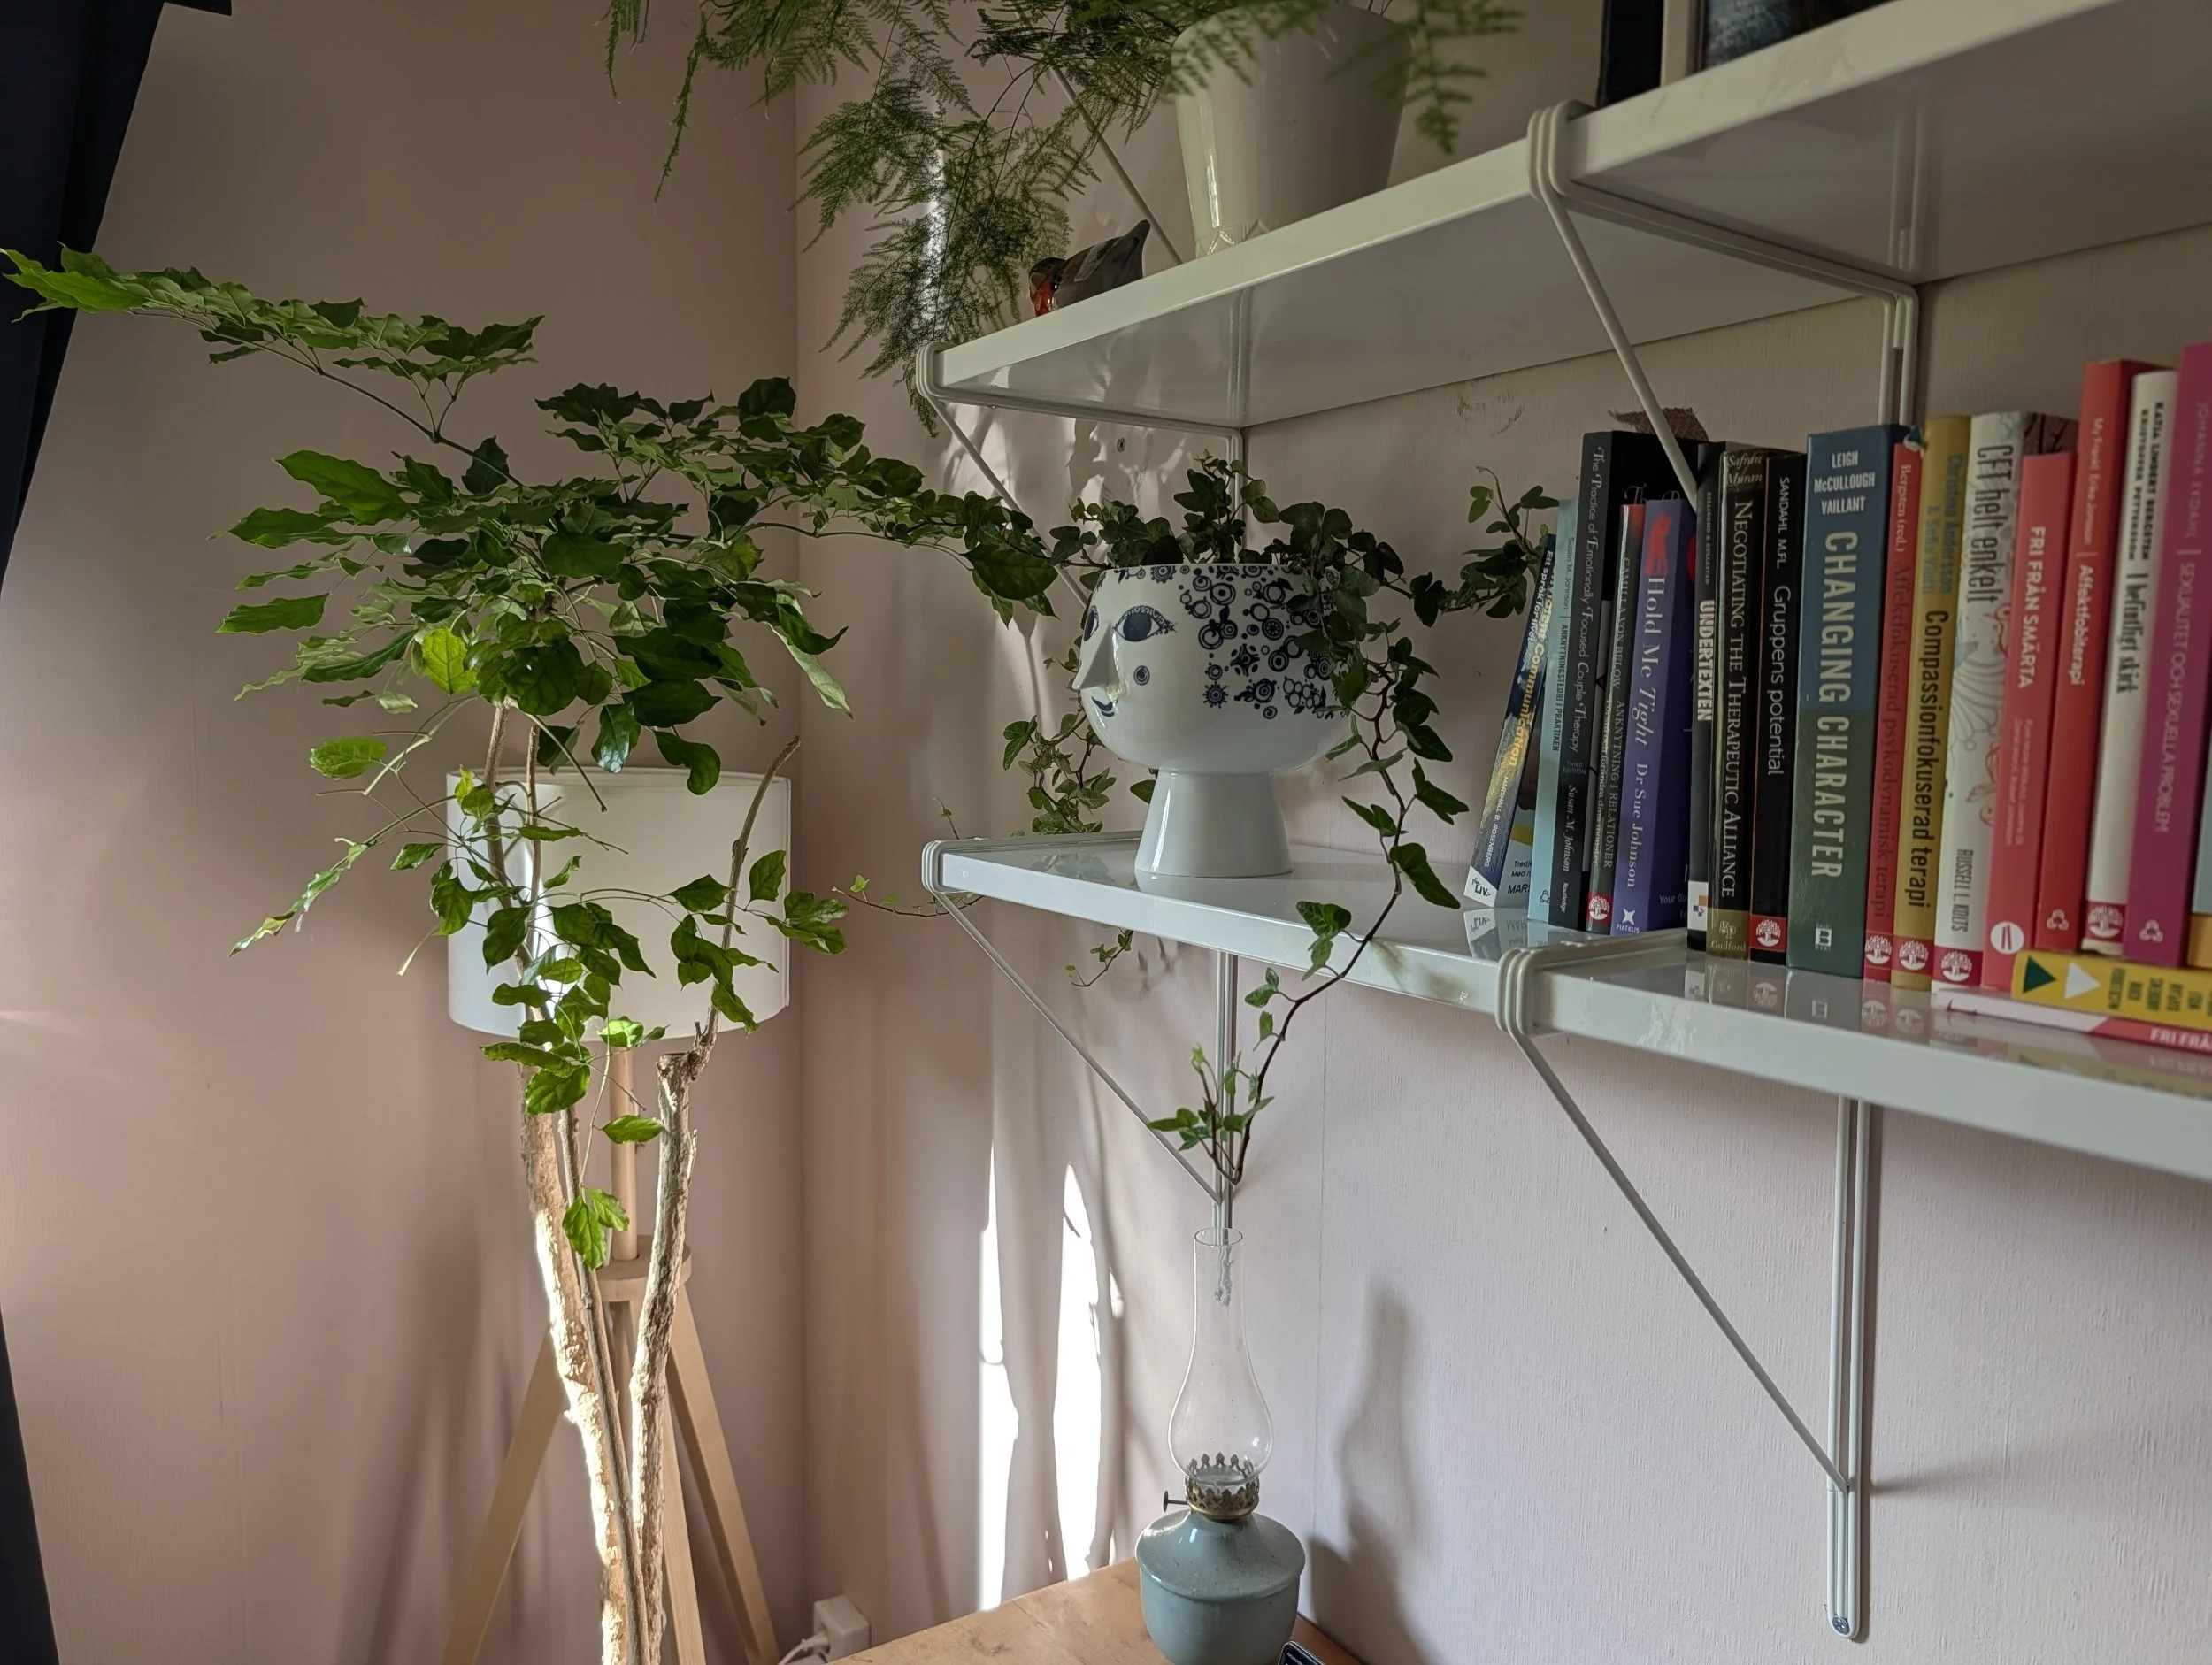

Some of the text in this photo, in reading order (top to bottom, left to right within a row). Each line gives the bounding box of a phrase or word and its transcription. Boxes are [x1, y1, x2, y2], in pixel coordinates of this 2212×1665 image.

[1727, 452, 1763, 468] Safran
[1832, 450, 1859, 469] LEIGH
[1814, 472, 1876, 493] McCULLOUGH
[1778, 476, 1790, 534] SANDAHL
[1821, 497, 1866, 515] VAILLANT
[1965, 442, 2015, 607] CFT helt enkelt
[1544, 550, 1554, 567] Ett
[2028, 526, 2047, 556] FRI
[1536, 566, 1550, 600] språk
[1563, 536, 1575, 610] Susan M. Johnson
[2024, 560, 2047, 611] FRÅN
[1569, 446, 1606, 753] The Practice of Emotionally Focused Couple Therapy
[2068, 564, 2094, 686] Affektfobiterapi
[1555, 624, 1569, 702] ANKNYTNINGSTEORI
[1612, 646, 1623, 690] BELOW
[1628, 577, 1666, 748] Hold Me Tight
[1697, 600, 1715, 722] UNDERTEXTEN
[1729, 635, 1744, 672] THE
[2016, 613, 2042, 690] SMÄRTA
[1765, 585, 1792, 775] Gruppens potential
[1508, 642, 1545, 768] Communication
[1810, 530, 1858, 879] CHANGING CHARACTER
[1552, 708, 1563, 752] PRAKTIKEN
[1609, 701, 1626, 781] ANKNYTNING
[1871, 561, 1911, 918] Affektfokuserad psykodynamisk terapi
[1904, 610, 1949, 908] Compassionfokuserad terapi
[1495, 776, 1509, 813] MARSHALL
[1567, 784, 1578, 816] Susan
[1484, 823, 1499, 868] ROSENBERG
[1602, 793, 1619, 869] RELATIONER
[1627, 763, 1648, 888] Dr Sue Johnson
[1560, 832, 1576, 872] Johnson
[1955, 848, 1973, 891] RUSSELL
[1559, 882, 1569, 913] Routledge
[1951, 903, 1970, 932] KOLTS
[1616, 923, 1640, 934] PIATKUS
[1711, 940, 1746, 952] Guilford
[2150, 1026, 2176, 1046] FRI
